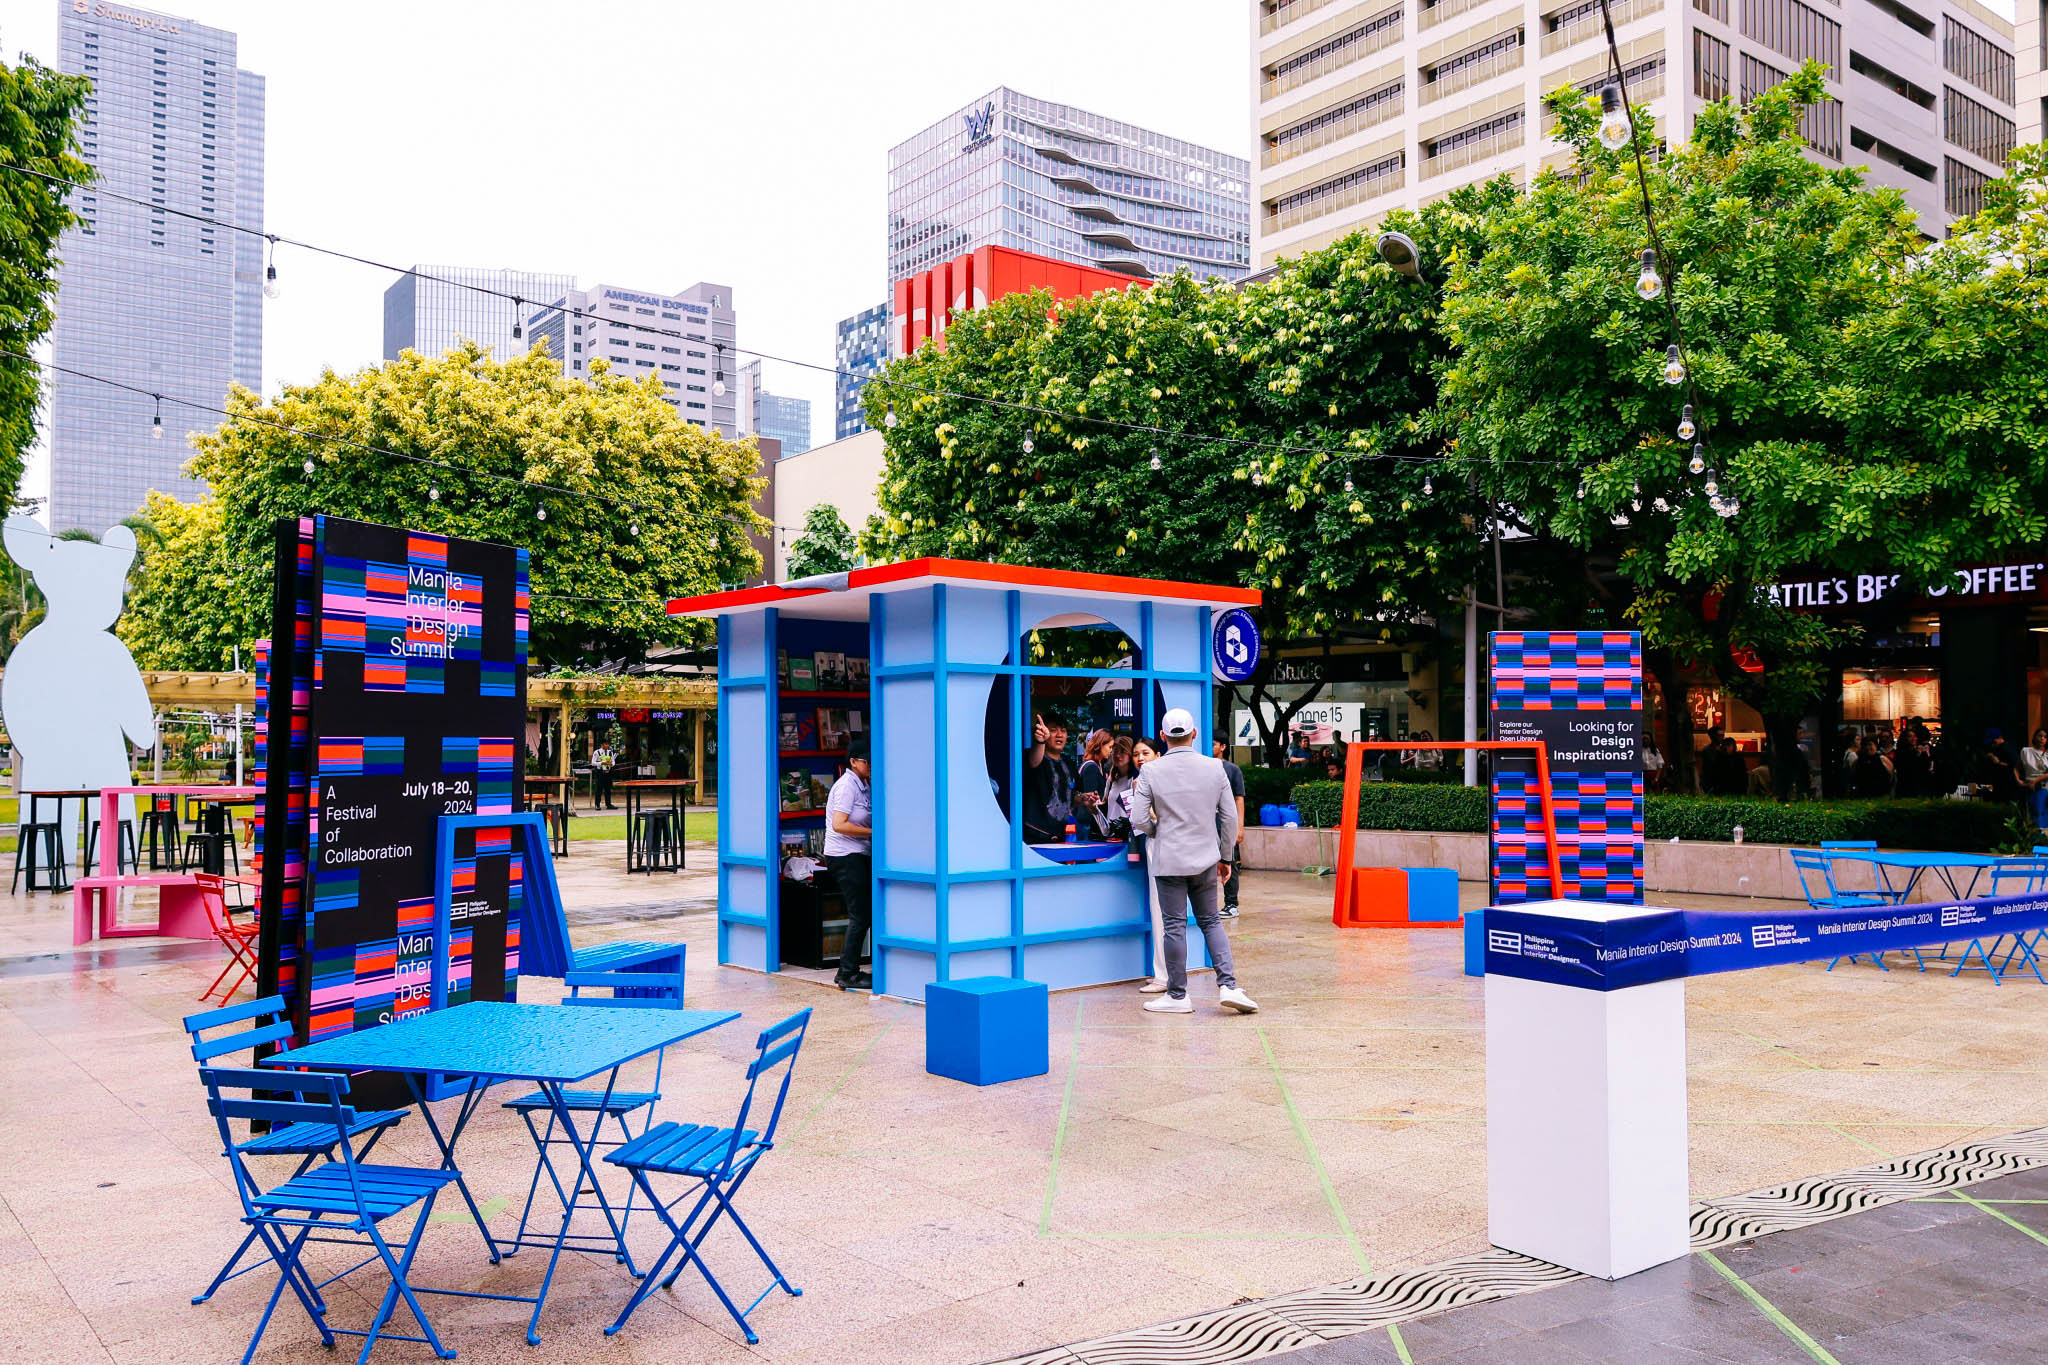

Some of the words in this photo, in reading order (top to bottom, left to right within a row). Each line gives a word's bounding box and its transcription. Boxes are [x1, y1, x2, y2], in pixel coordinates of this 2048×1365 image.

[604, 289, 660, 307] AMERICAN
[662, 298, 709, 315] EXPRESS
[408, 566, 463, 591] Manila
[405, 589, 465, 613] Interior
[412, 614, 468, 642] Design
[390, 636, 455, 660] Summit
[1329, 706, 1343, 723] 15
[1569, 721, 1615, 734] Looking
[1616, 721, 1634, 732] for
[1591, 735, 1634, 748] Design
[1553, 750, 1634, 763] Inspirations?
[326, 785, 336, 800] A
[402, 783, 429, 799] July
[326, 804, 377, 822] Festival
[444, 800, 473, 814] 2024
[325, 828, 340, 843] of
[325, 844, 412, 864] Collaboration
[1818, 922, 1842, 935] Manila
[1842, 919, 1868, 933] Interior
[1868, 916, 1892, 931] Design
[1892, 914, 1917, 928] Summit
[1917, 912, 1933, 924] 2024
[1524, 934, 1555, 946] Philippine
[1524, 943, 1550, 952] Institute
[1596, 944, 1627, 962] Manila
[1628, 942, 1659, 958] Interior
[1660, 937, 1689, 954] Design
[1690, 934, 1721, 949] Summit
[1721, 932, 1742, 945] 2024
[1524, 951, 1548, 960] Interior
[1548, 953, 1581, 964] Designers
